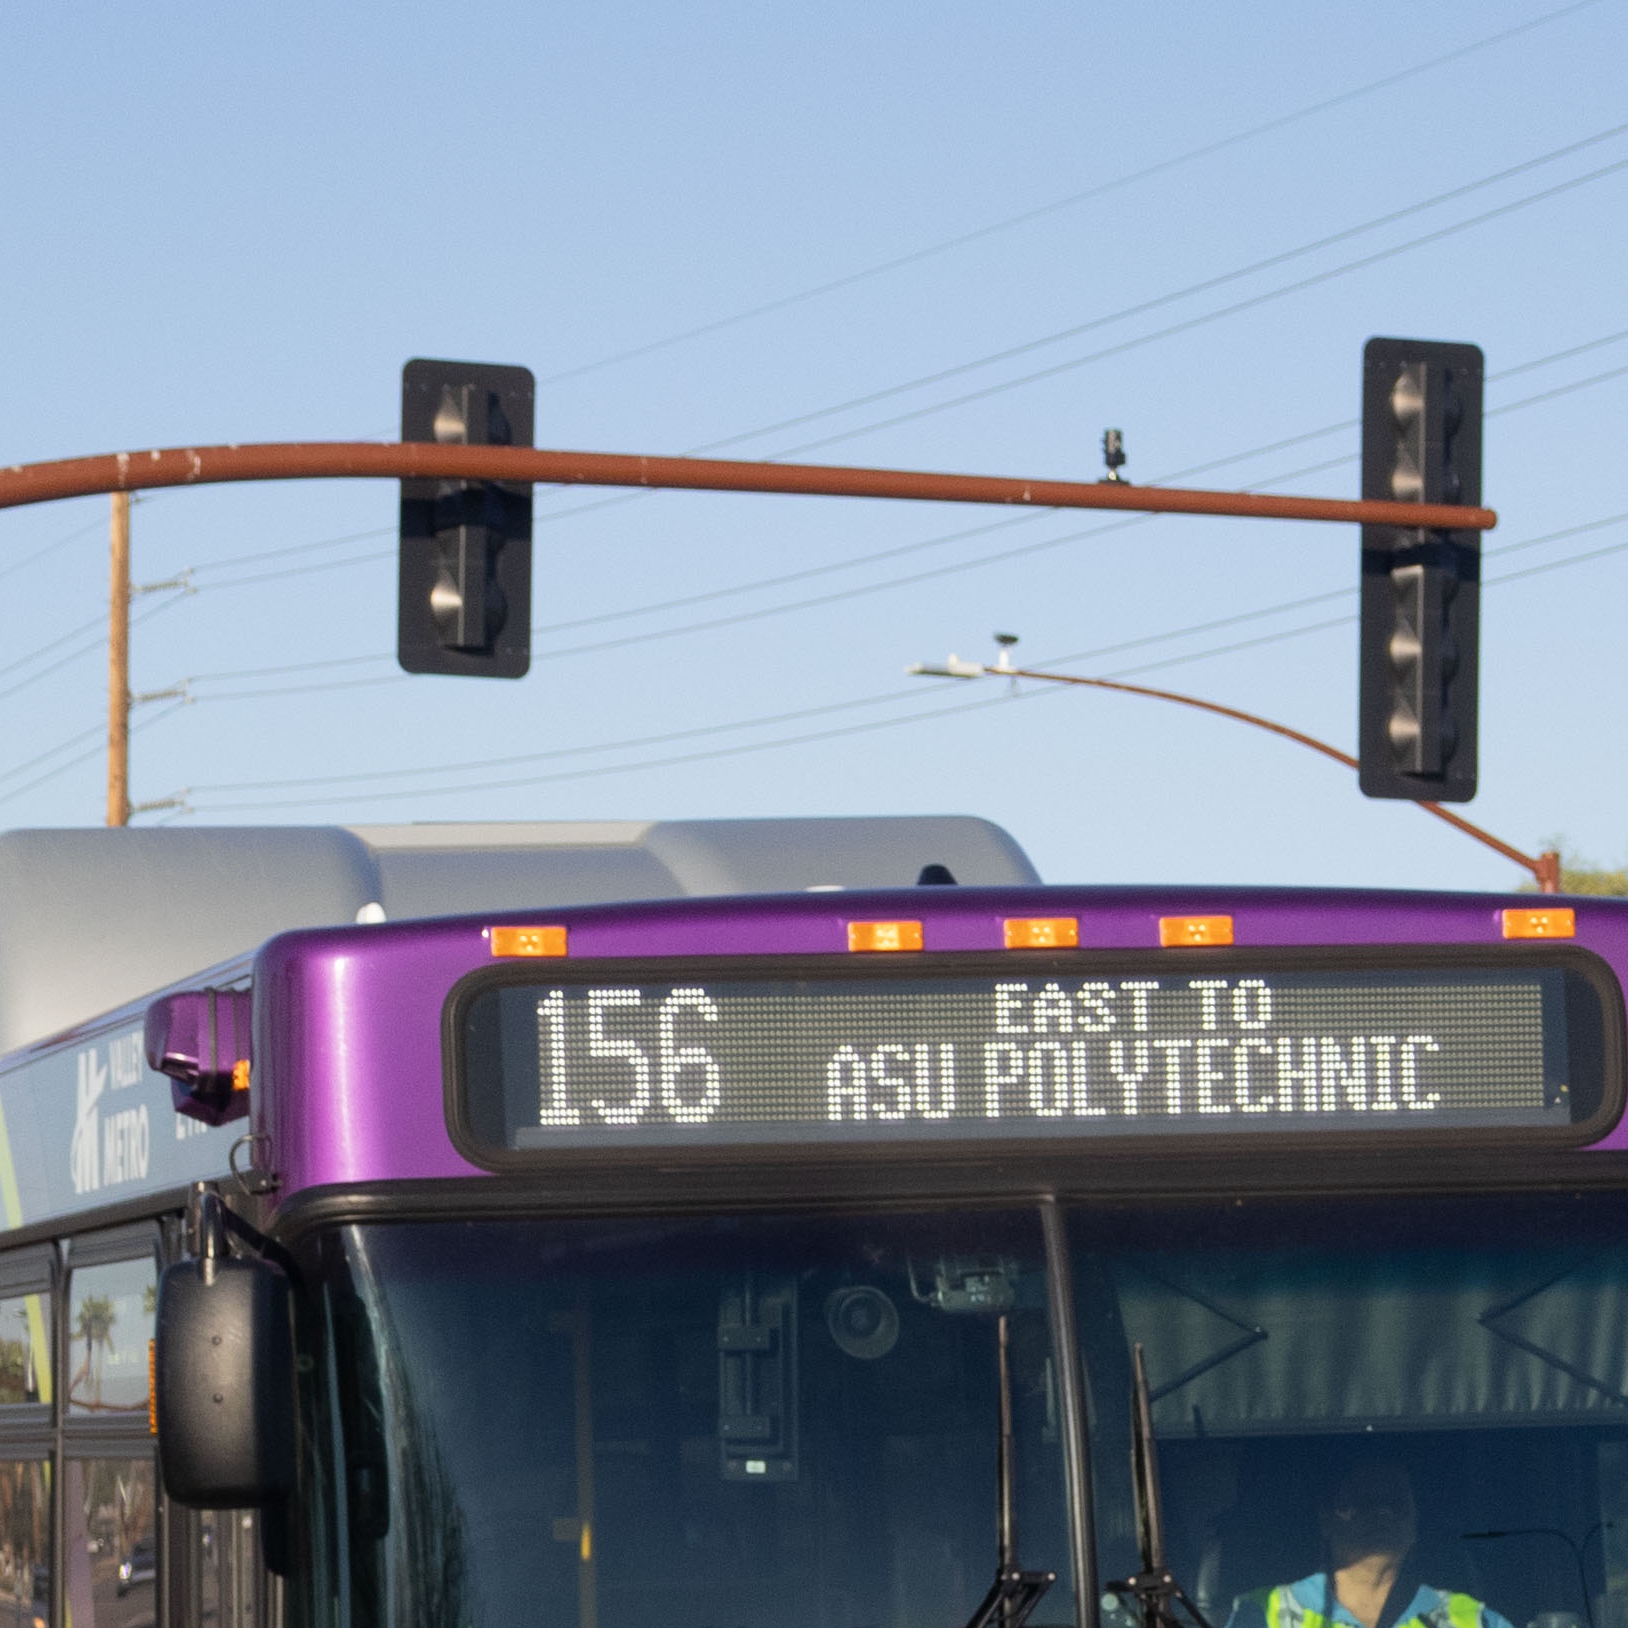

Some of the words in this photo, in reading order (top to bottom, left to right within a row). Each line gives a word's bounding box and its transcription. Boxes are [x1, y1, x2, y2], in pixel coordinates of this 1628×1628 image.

[995, 982, 1159, 1034] EAST
[1189, 979, 1273, 1030] TO
[537, 988, 721, 1126] 156
[827, 1043, 957, 1121] ASU
[984, 1034, 1441, 1118] POLYTECHNIC
